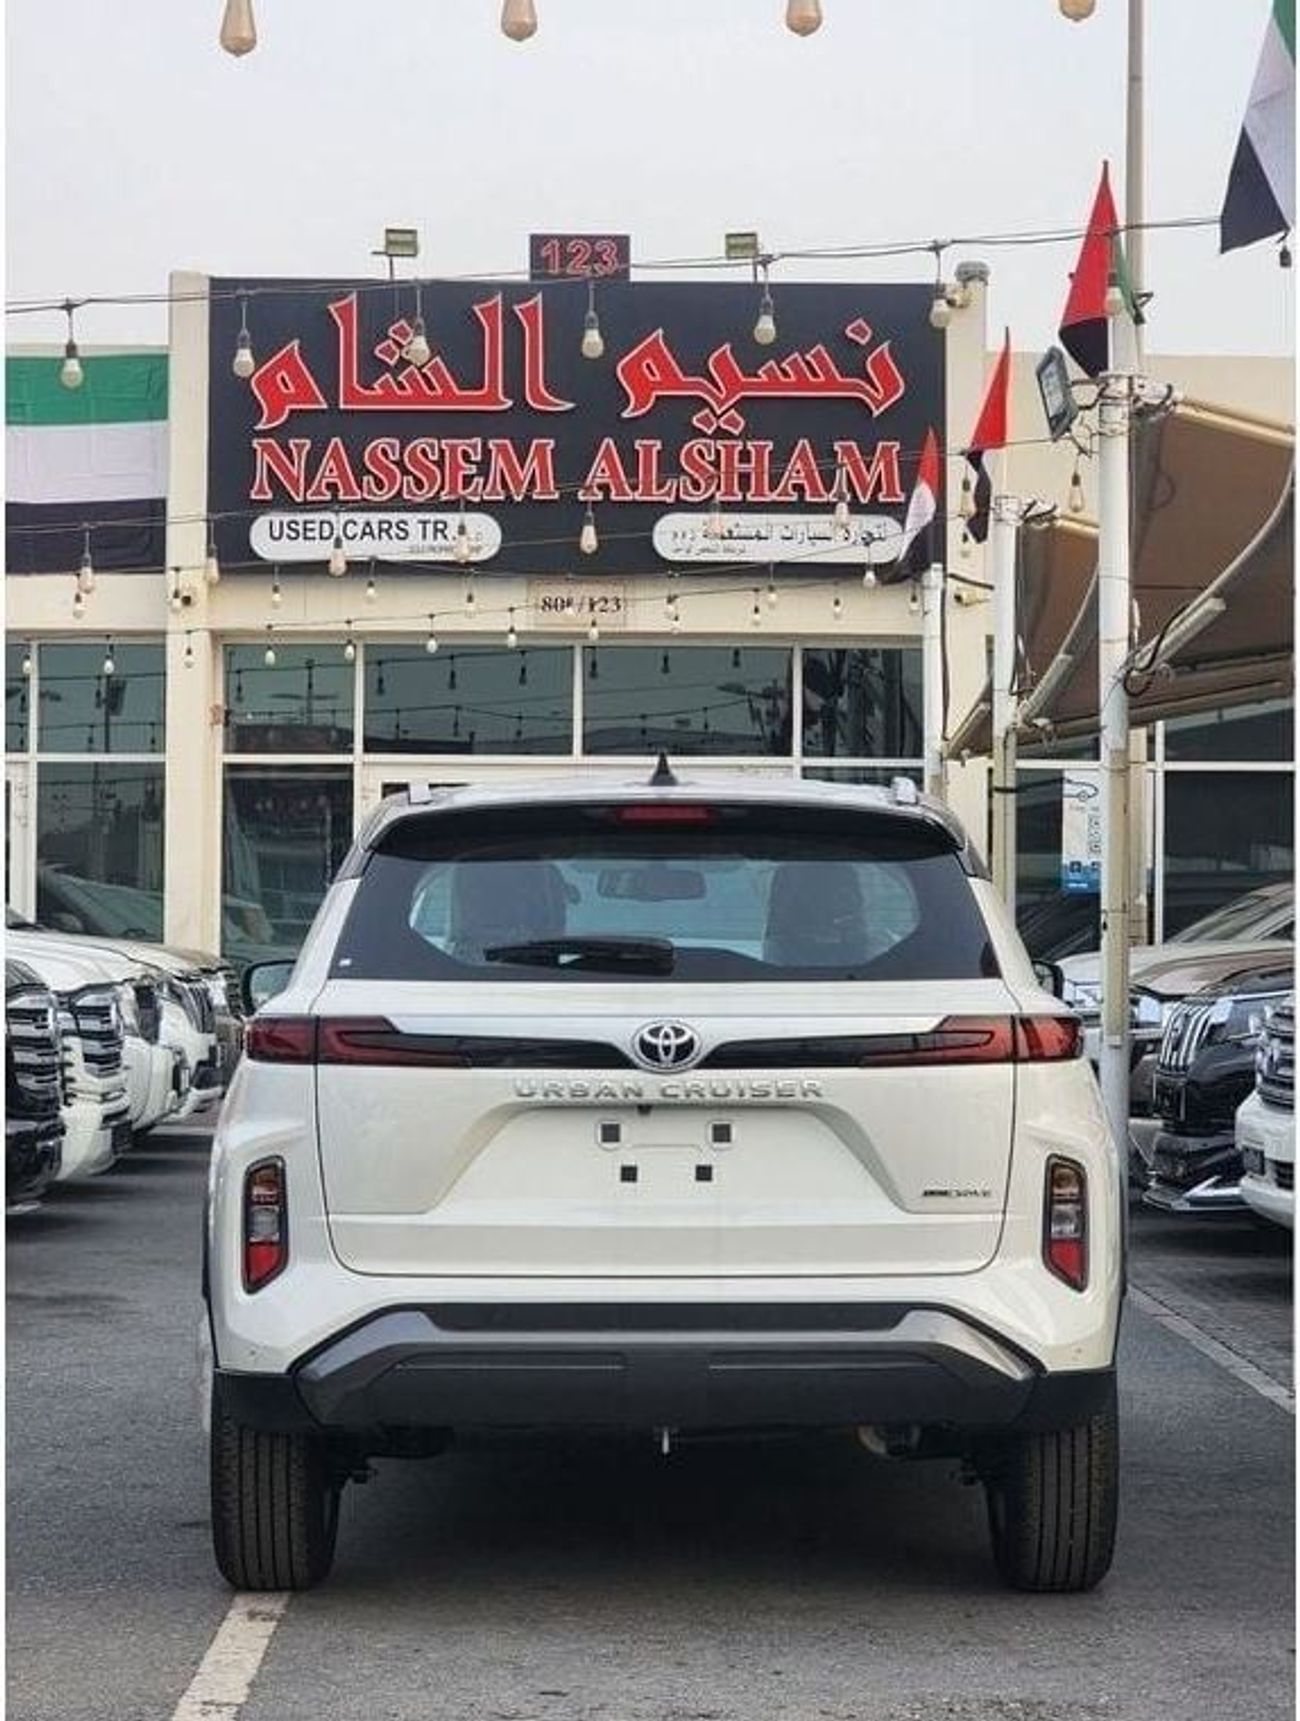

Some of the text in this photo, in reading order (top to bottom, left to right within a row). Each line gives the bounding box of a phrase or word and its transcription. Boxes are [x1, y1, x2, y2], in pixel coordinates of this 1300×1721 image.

[542, 239, 618, 277] 123
[250, 291, 905, 435] نسيم الشام
[250, 437, 904, 503] NASSEM ALSHAM
[269, 519, 334, 541] USED
[342, 519, 409, 541] CARS
[513, 1078, 824, 1098] URBAN CRUISER
